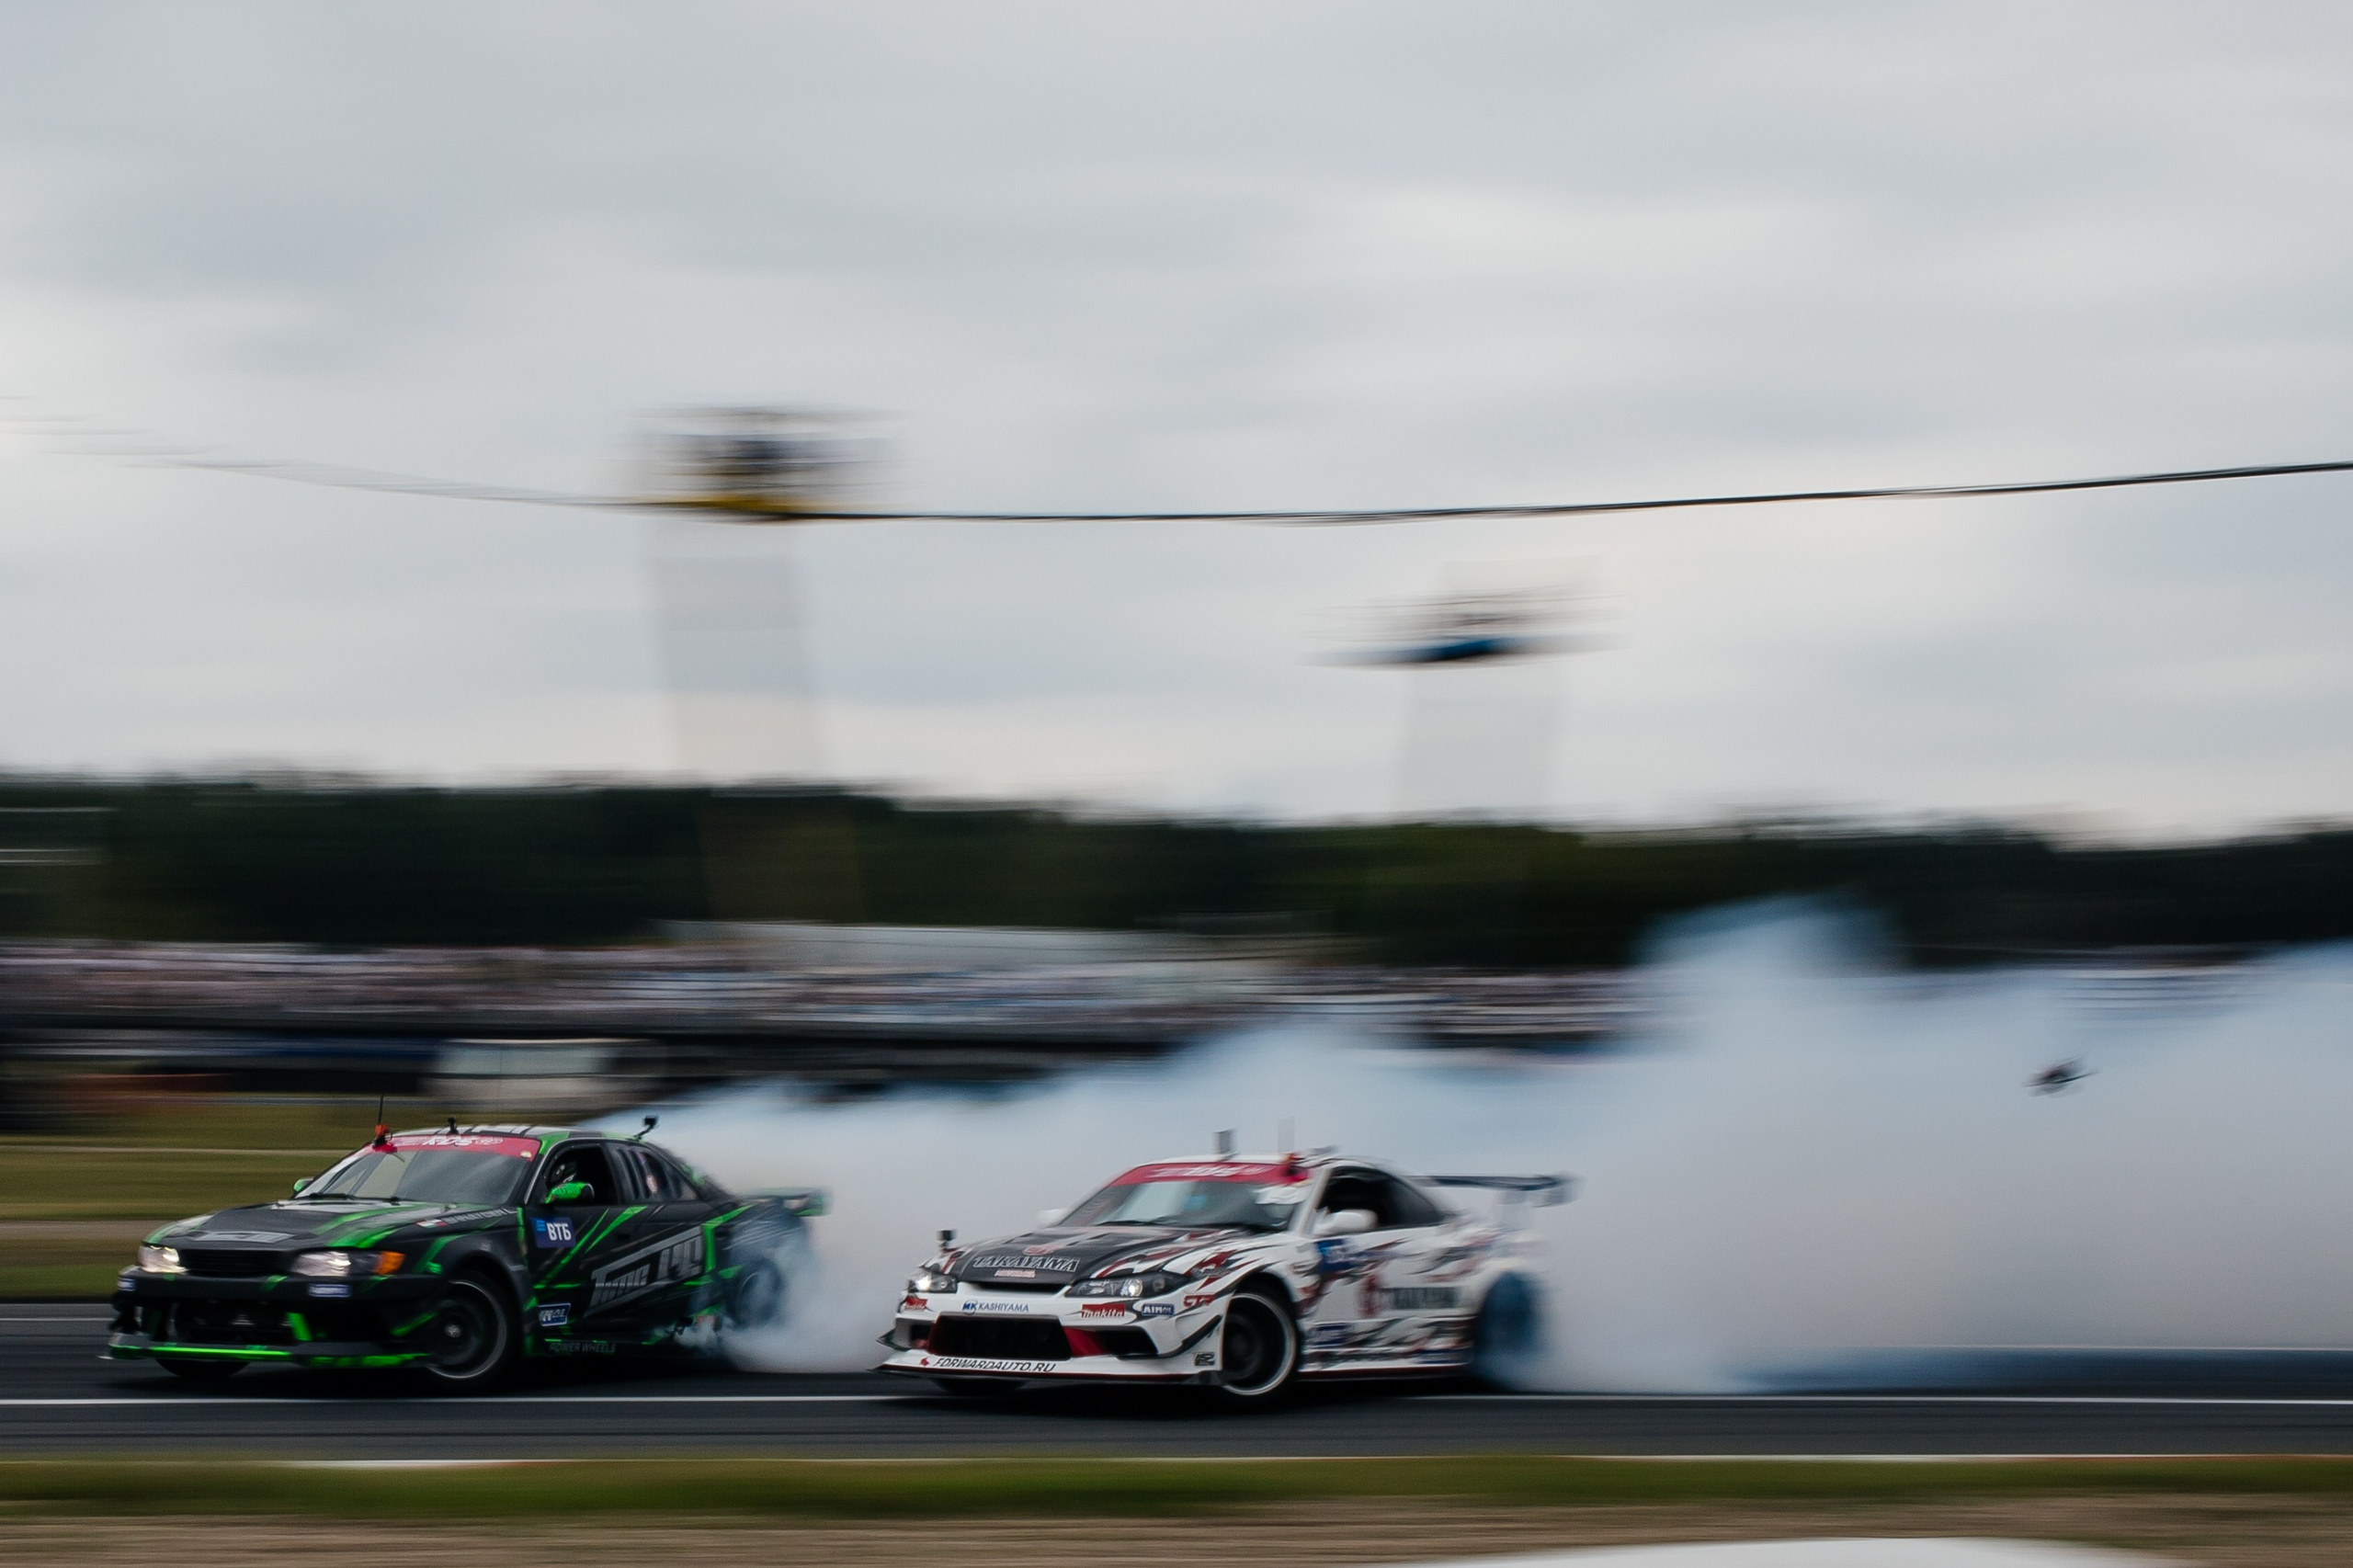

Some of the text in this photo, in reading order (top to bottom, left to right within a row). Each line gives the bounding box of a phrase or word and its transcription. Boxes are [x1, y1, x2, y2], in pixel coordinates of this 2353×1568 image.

[547, 1222, 572, 1241] ВТБ
[973, 1255, 1081, 1272] TAKAYAMA
[978, 1302, 1029, 1313] KASHIYAMA
[1082, 1307, 1125, 1318] makita
[933, 1358, 1056, 1372] FORWARDAUTO.RU
